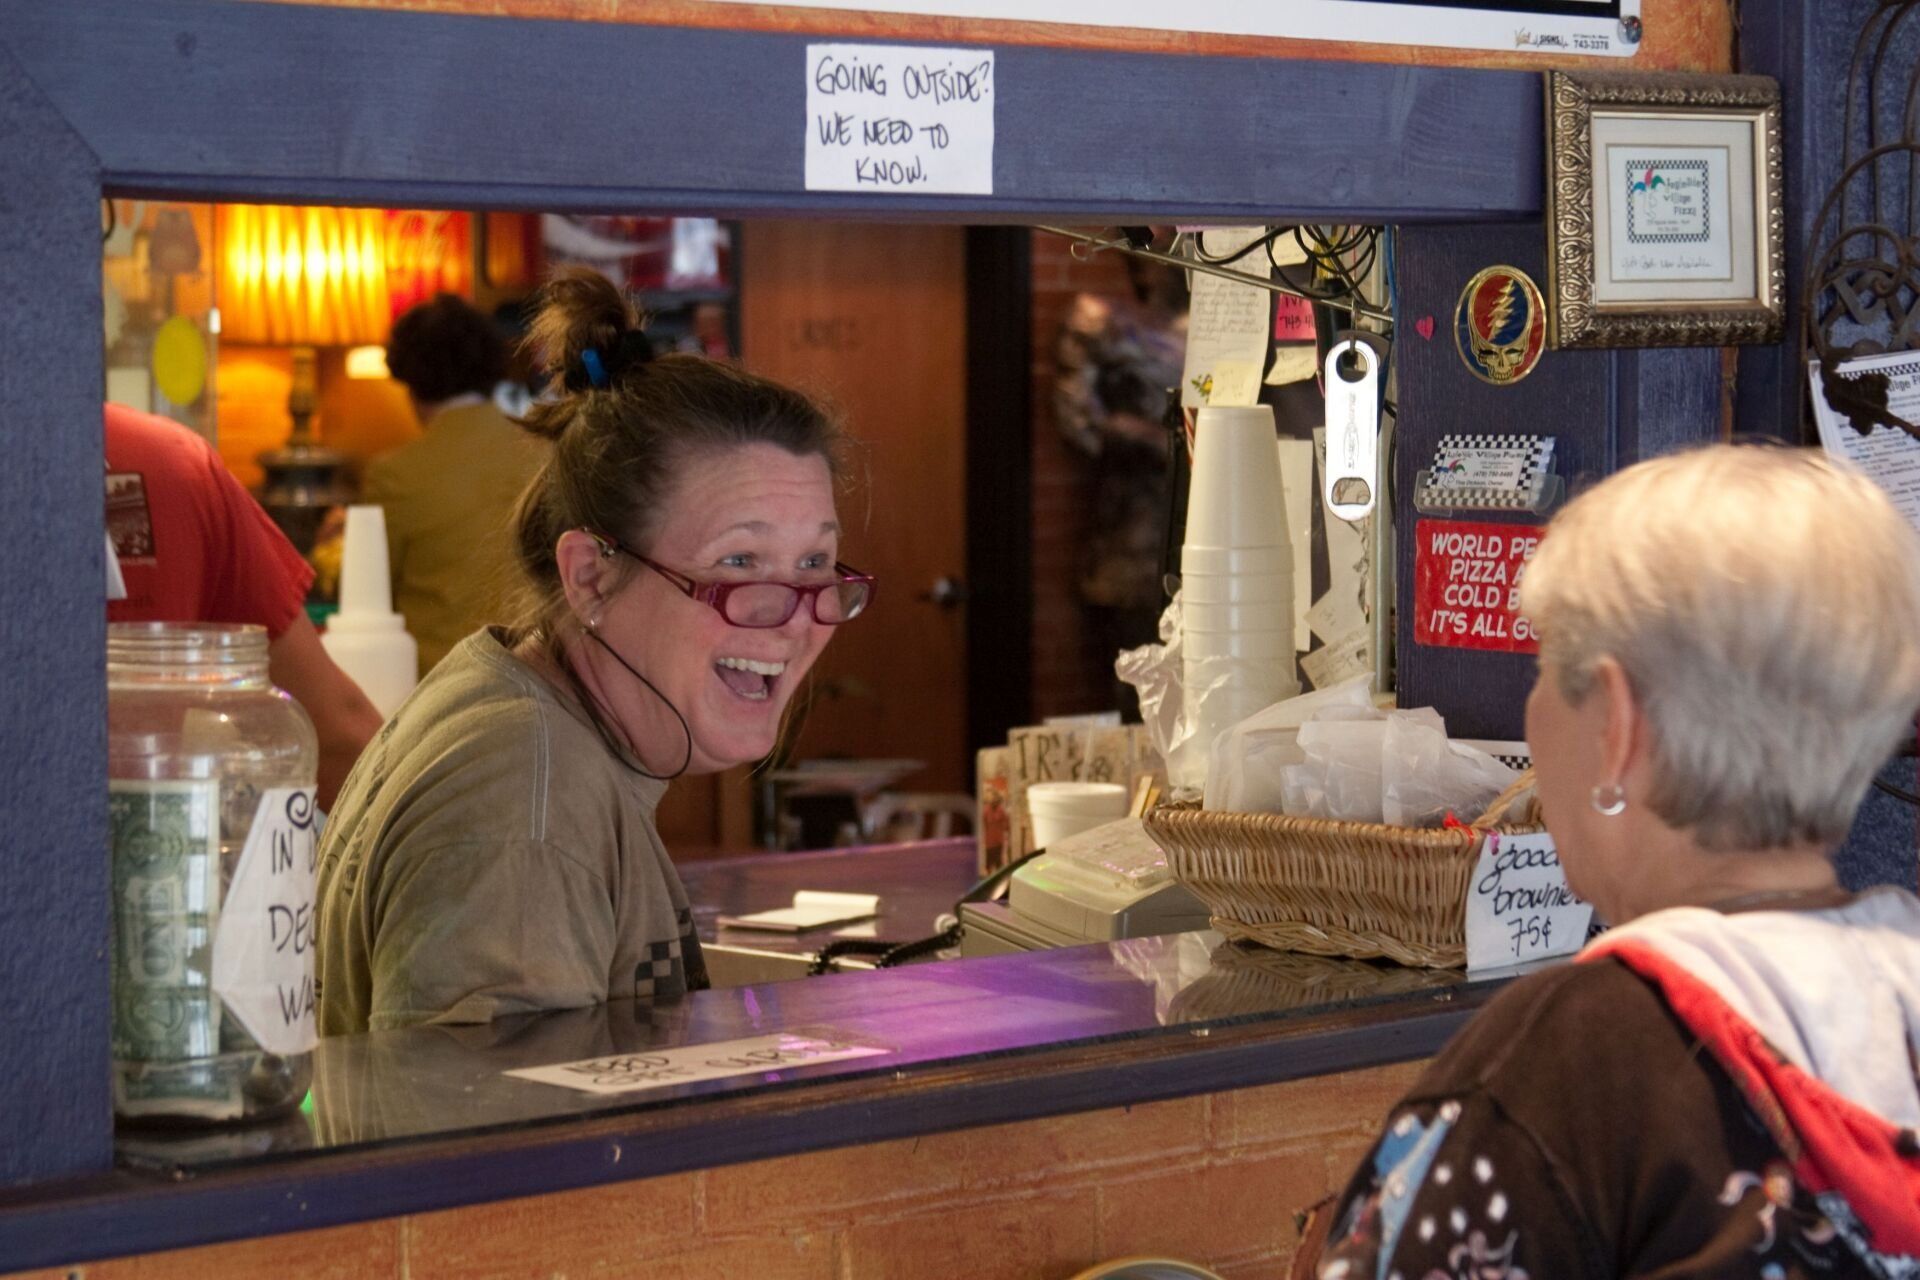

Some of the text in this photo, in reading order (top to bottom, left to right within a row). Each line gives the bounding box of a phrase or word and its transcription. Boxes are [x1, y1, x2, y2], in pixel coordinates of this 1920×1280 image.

[816, 56, 990, 105] GOING OUTSIDE?
[818, 112, 949, 149] WE NEED TO
[855, 155, 927, 185] KNOW.
[1432, 532, 1537, 560] WORLD PE
[1449, 558, 1507, 585] PIZZA
[1444, 585, 1500, 608] COLD
[1430, 609, 1467, 634] IT'S
[1471, 614, 1508, 637] ALL
